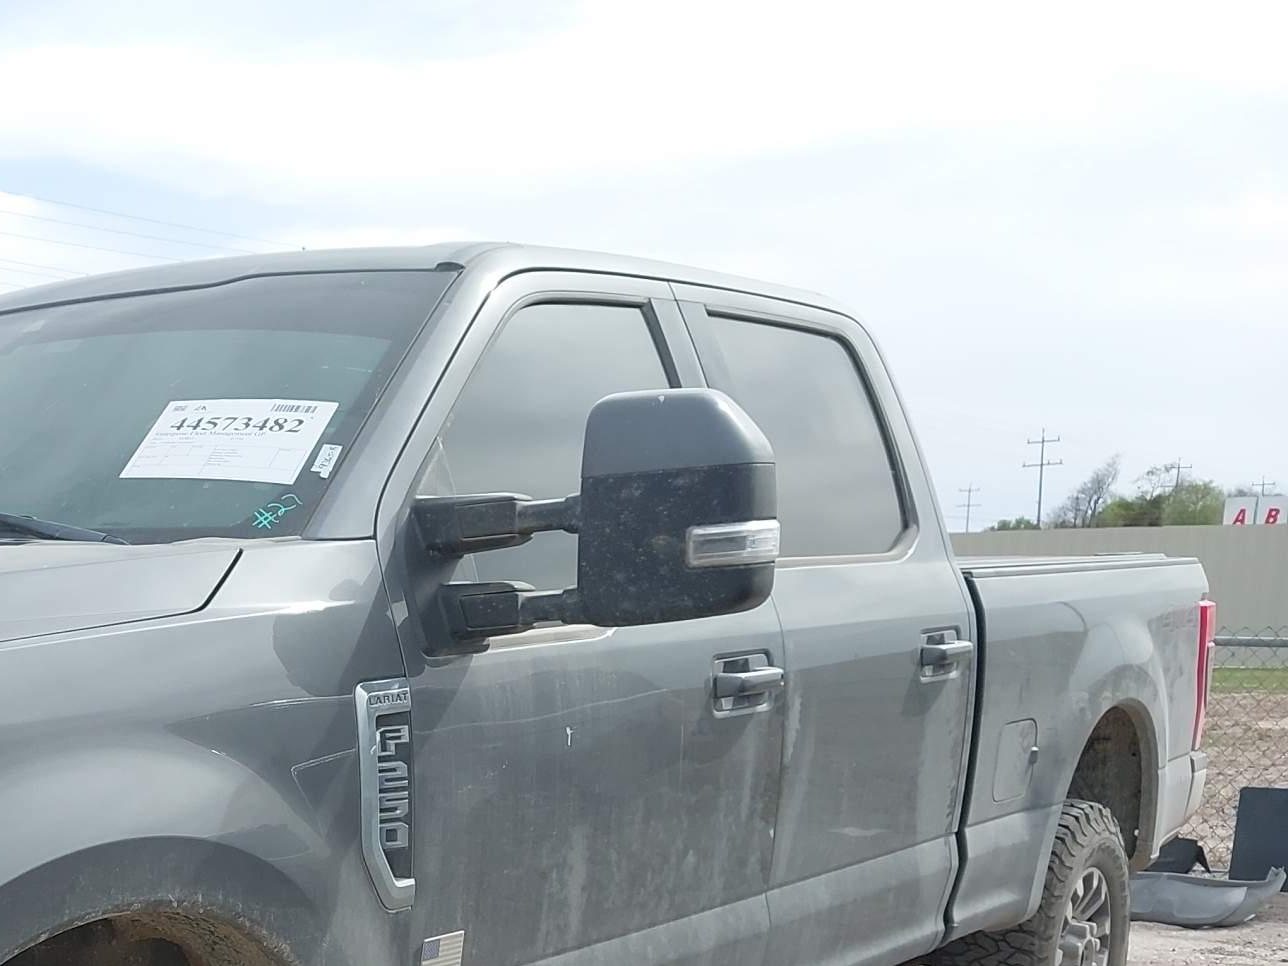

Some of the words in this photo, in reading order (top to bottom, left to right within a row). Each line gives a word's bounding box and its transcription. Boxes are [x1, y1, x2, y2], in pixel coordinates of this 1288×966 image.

[170, 416, 305, 433] 44573482
[1232, 508, 1247, 525] A
[1264, 508, 1280, 525] B
[368, 692, 409, 706] LARIAT
